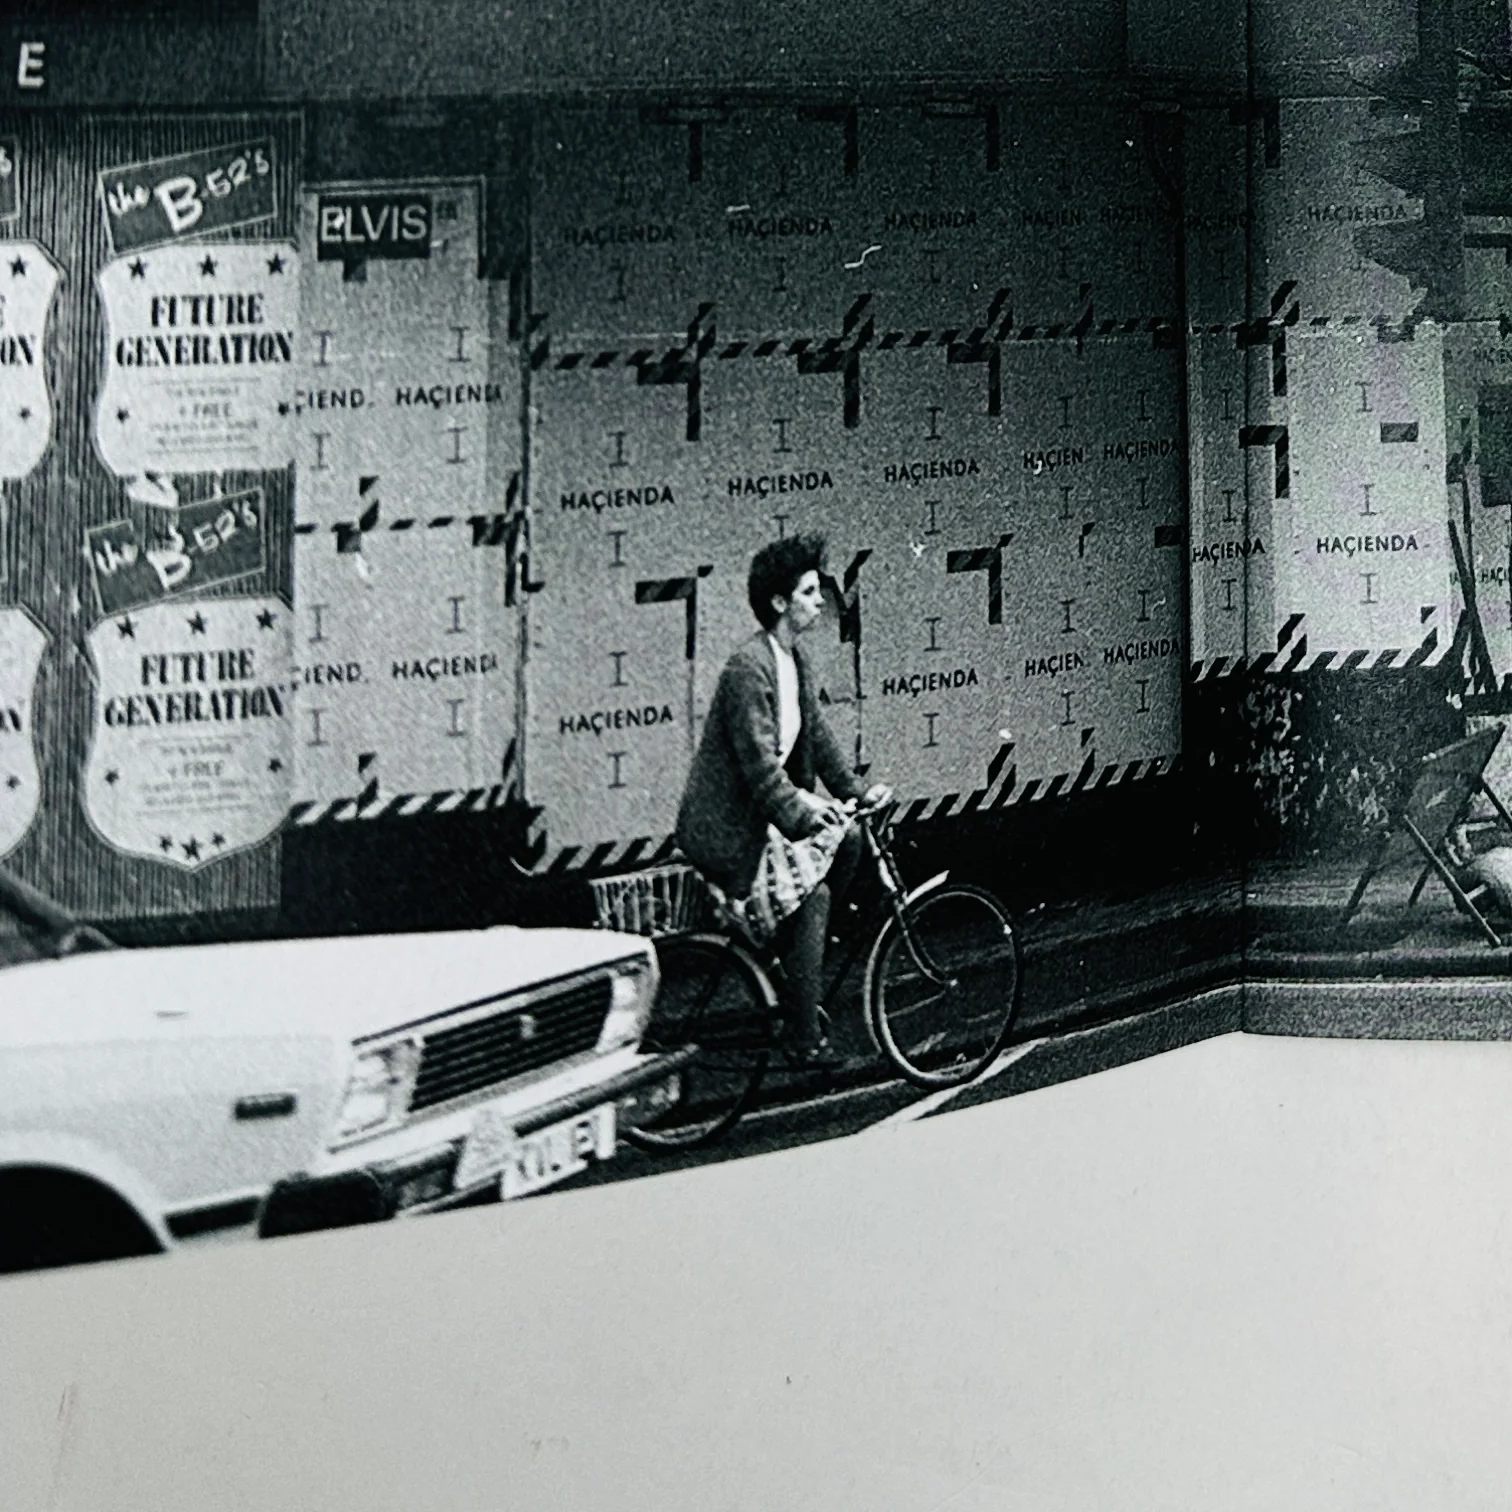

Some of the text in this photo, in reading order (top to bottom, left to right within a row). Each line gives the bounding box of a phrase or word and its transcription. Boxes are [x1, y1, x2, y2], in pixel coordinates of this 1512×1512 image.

[18, 42, 46, 87] E
[321, 203, 428, 242] ELVIS
[152, 292, 265, 328] FUTURE
[116, 331, 293, 368] GENERATION
[727, 471, 834, 500] HAÇIENDA
[884, 458, 981, 487] HAÇIENDA
[560, 484, 675, 514] HAÇIENDA
[1316, 534, 1420, 559] HAÇIENDA
[141, 648, 255, 686] FUTURE
[881, 667, 979, 697] HAÇIENDA
[105, 685, 286, 727] GENERATION
[559, 704, 674, 735] HAÇIENDA
